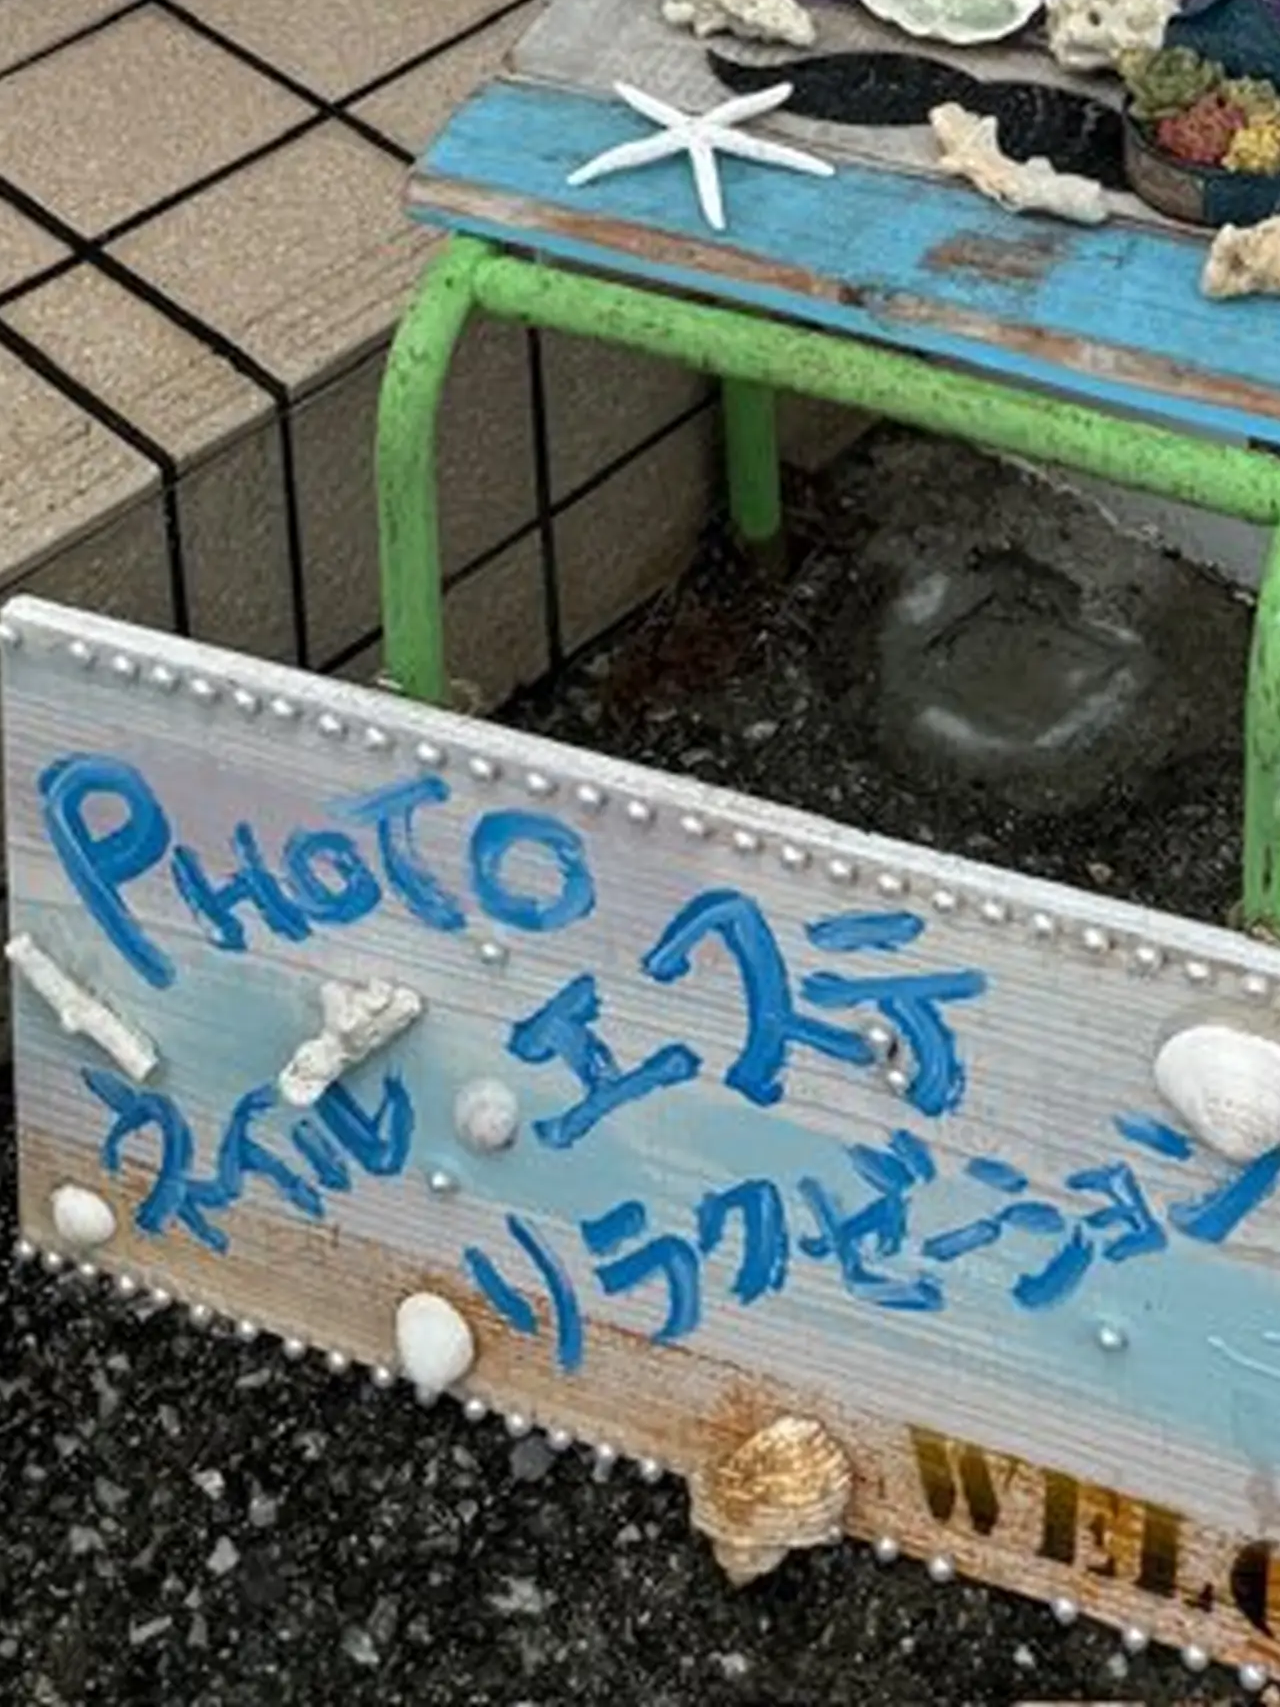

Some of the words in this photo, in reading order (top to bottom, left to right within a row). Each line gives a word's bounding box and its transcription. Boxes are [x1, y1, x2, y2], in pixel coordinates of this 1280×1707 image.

[38, 751, 596, 988] PHOTO
[508, 888, 988, 1149] エステ
